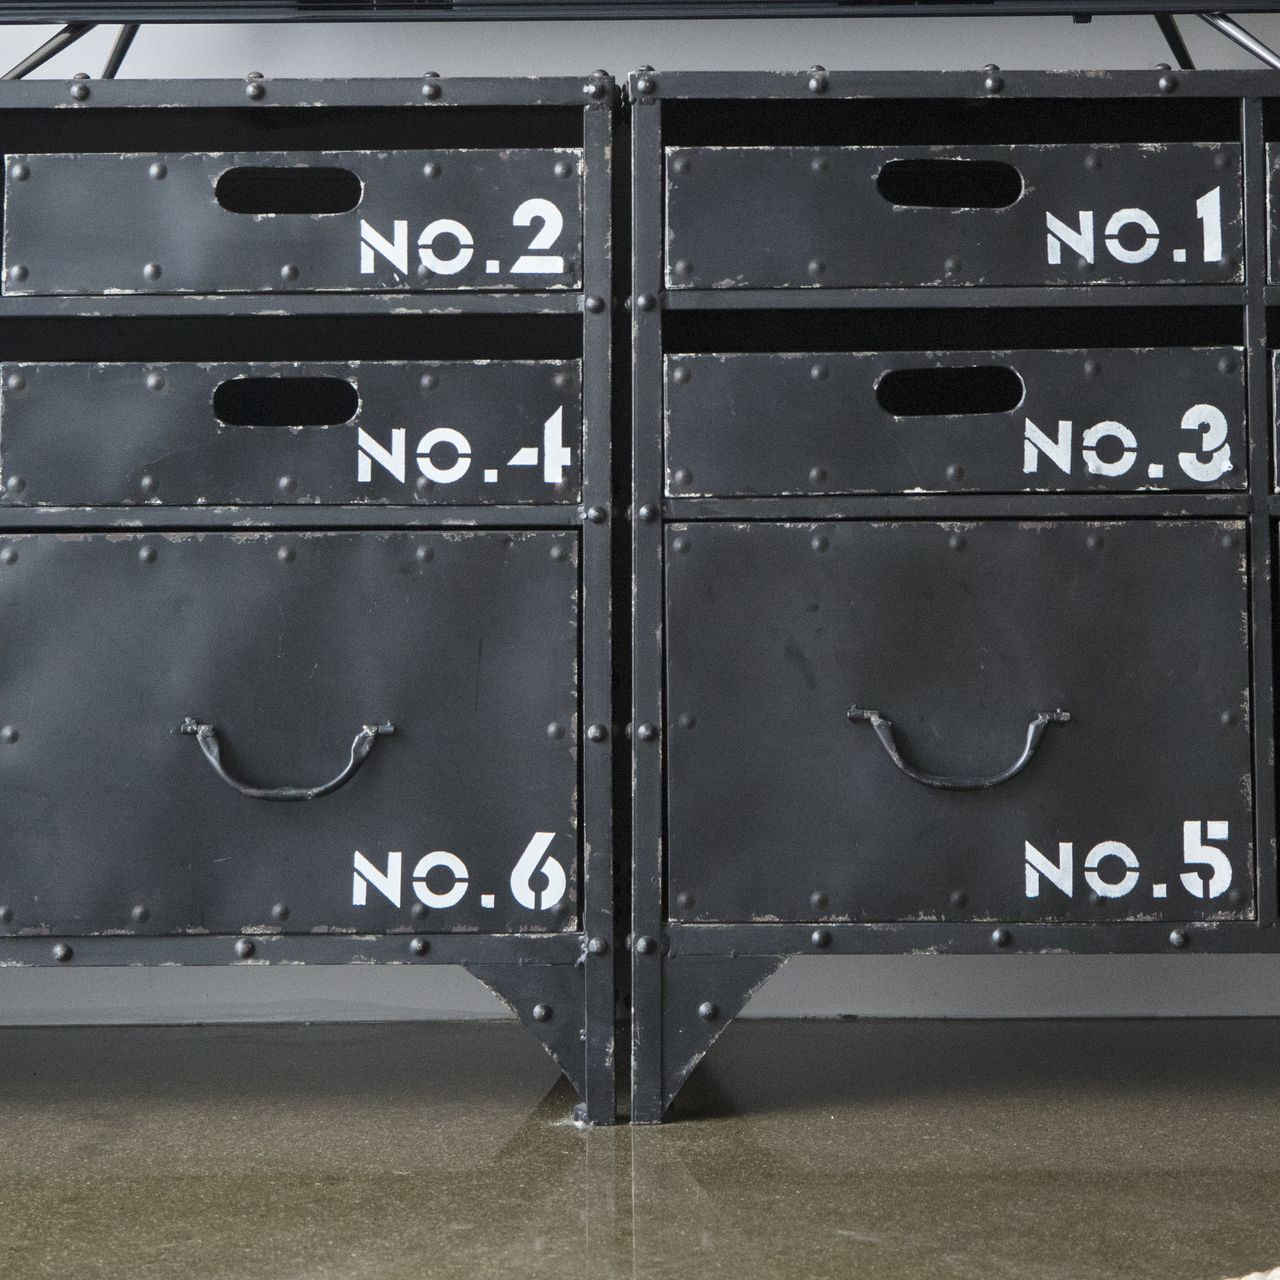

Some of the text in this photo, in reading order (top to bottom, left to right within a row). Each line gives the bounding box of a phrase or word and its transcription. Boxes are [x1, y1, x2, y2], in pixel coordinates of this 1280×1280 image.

[358, 196, 566, 276] NO.2
[1044, 184, 1224, 266] NO.1
[356, 404, 573, 487] NO.4
[1021, 402, 1235, 483] NO.3
[351, 830, 568, 912] NO.6
[1023, 819, 1234, 900] NO.5
